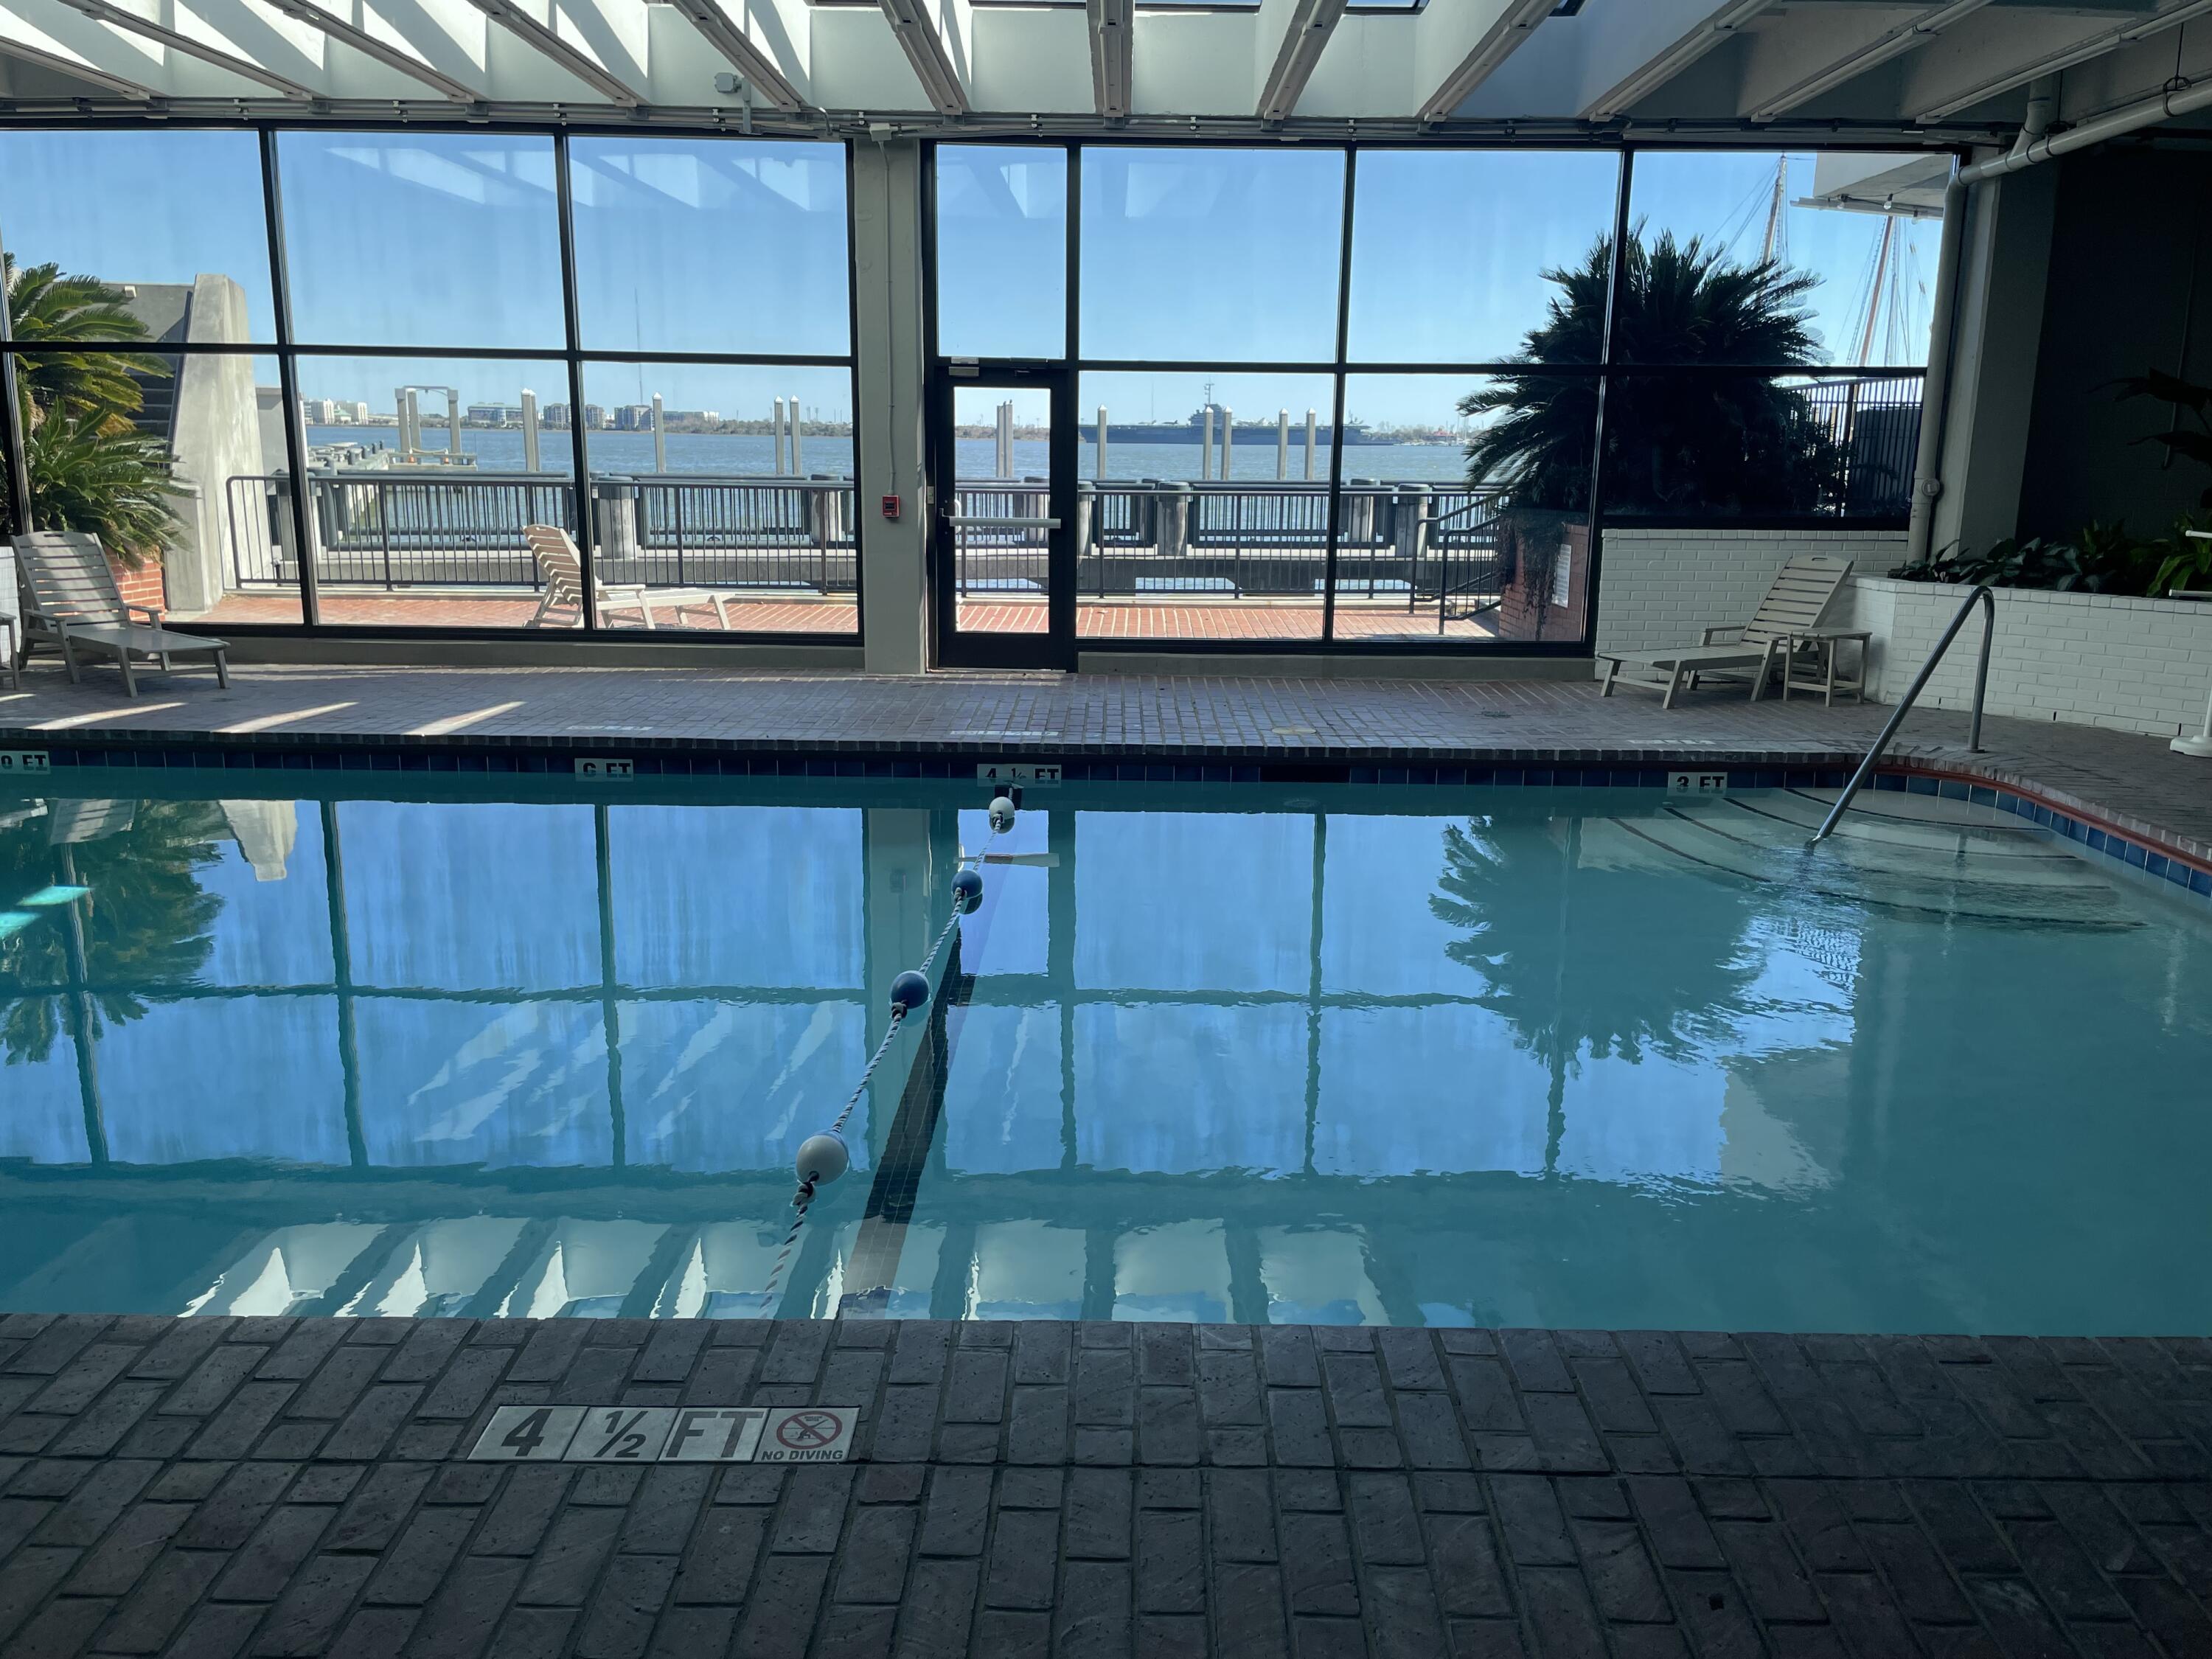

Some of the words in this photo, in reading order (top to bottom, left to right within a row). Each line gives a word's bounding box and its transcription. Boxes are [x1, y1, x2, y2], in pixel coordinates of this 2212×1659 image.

[21, 754, 47, 769] FT
[605, 762, 631, 776] FT
[1034, 768, 1059, 782] FT
[1699, 776, 1725, 791] FT
[501, 1408, 554, 1457] 4
[666, 1411, 764, 1458] FT
[760, 1450, 785, 1461] NO
[788, 1450, 844, 1461] DIVING
